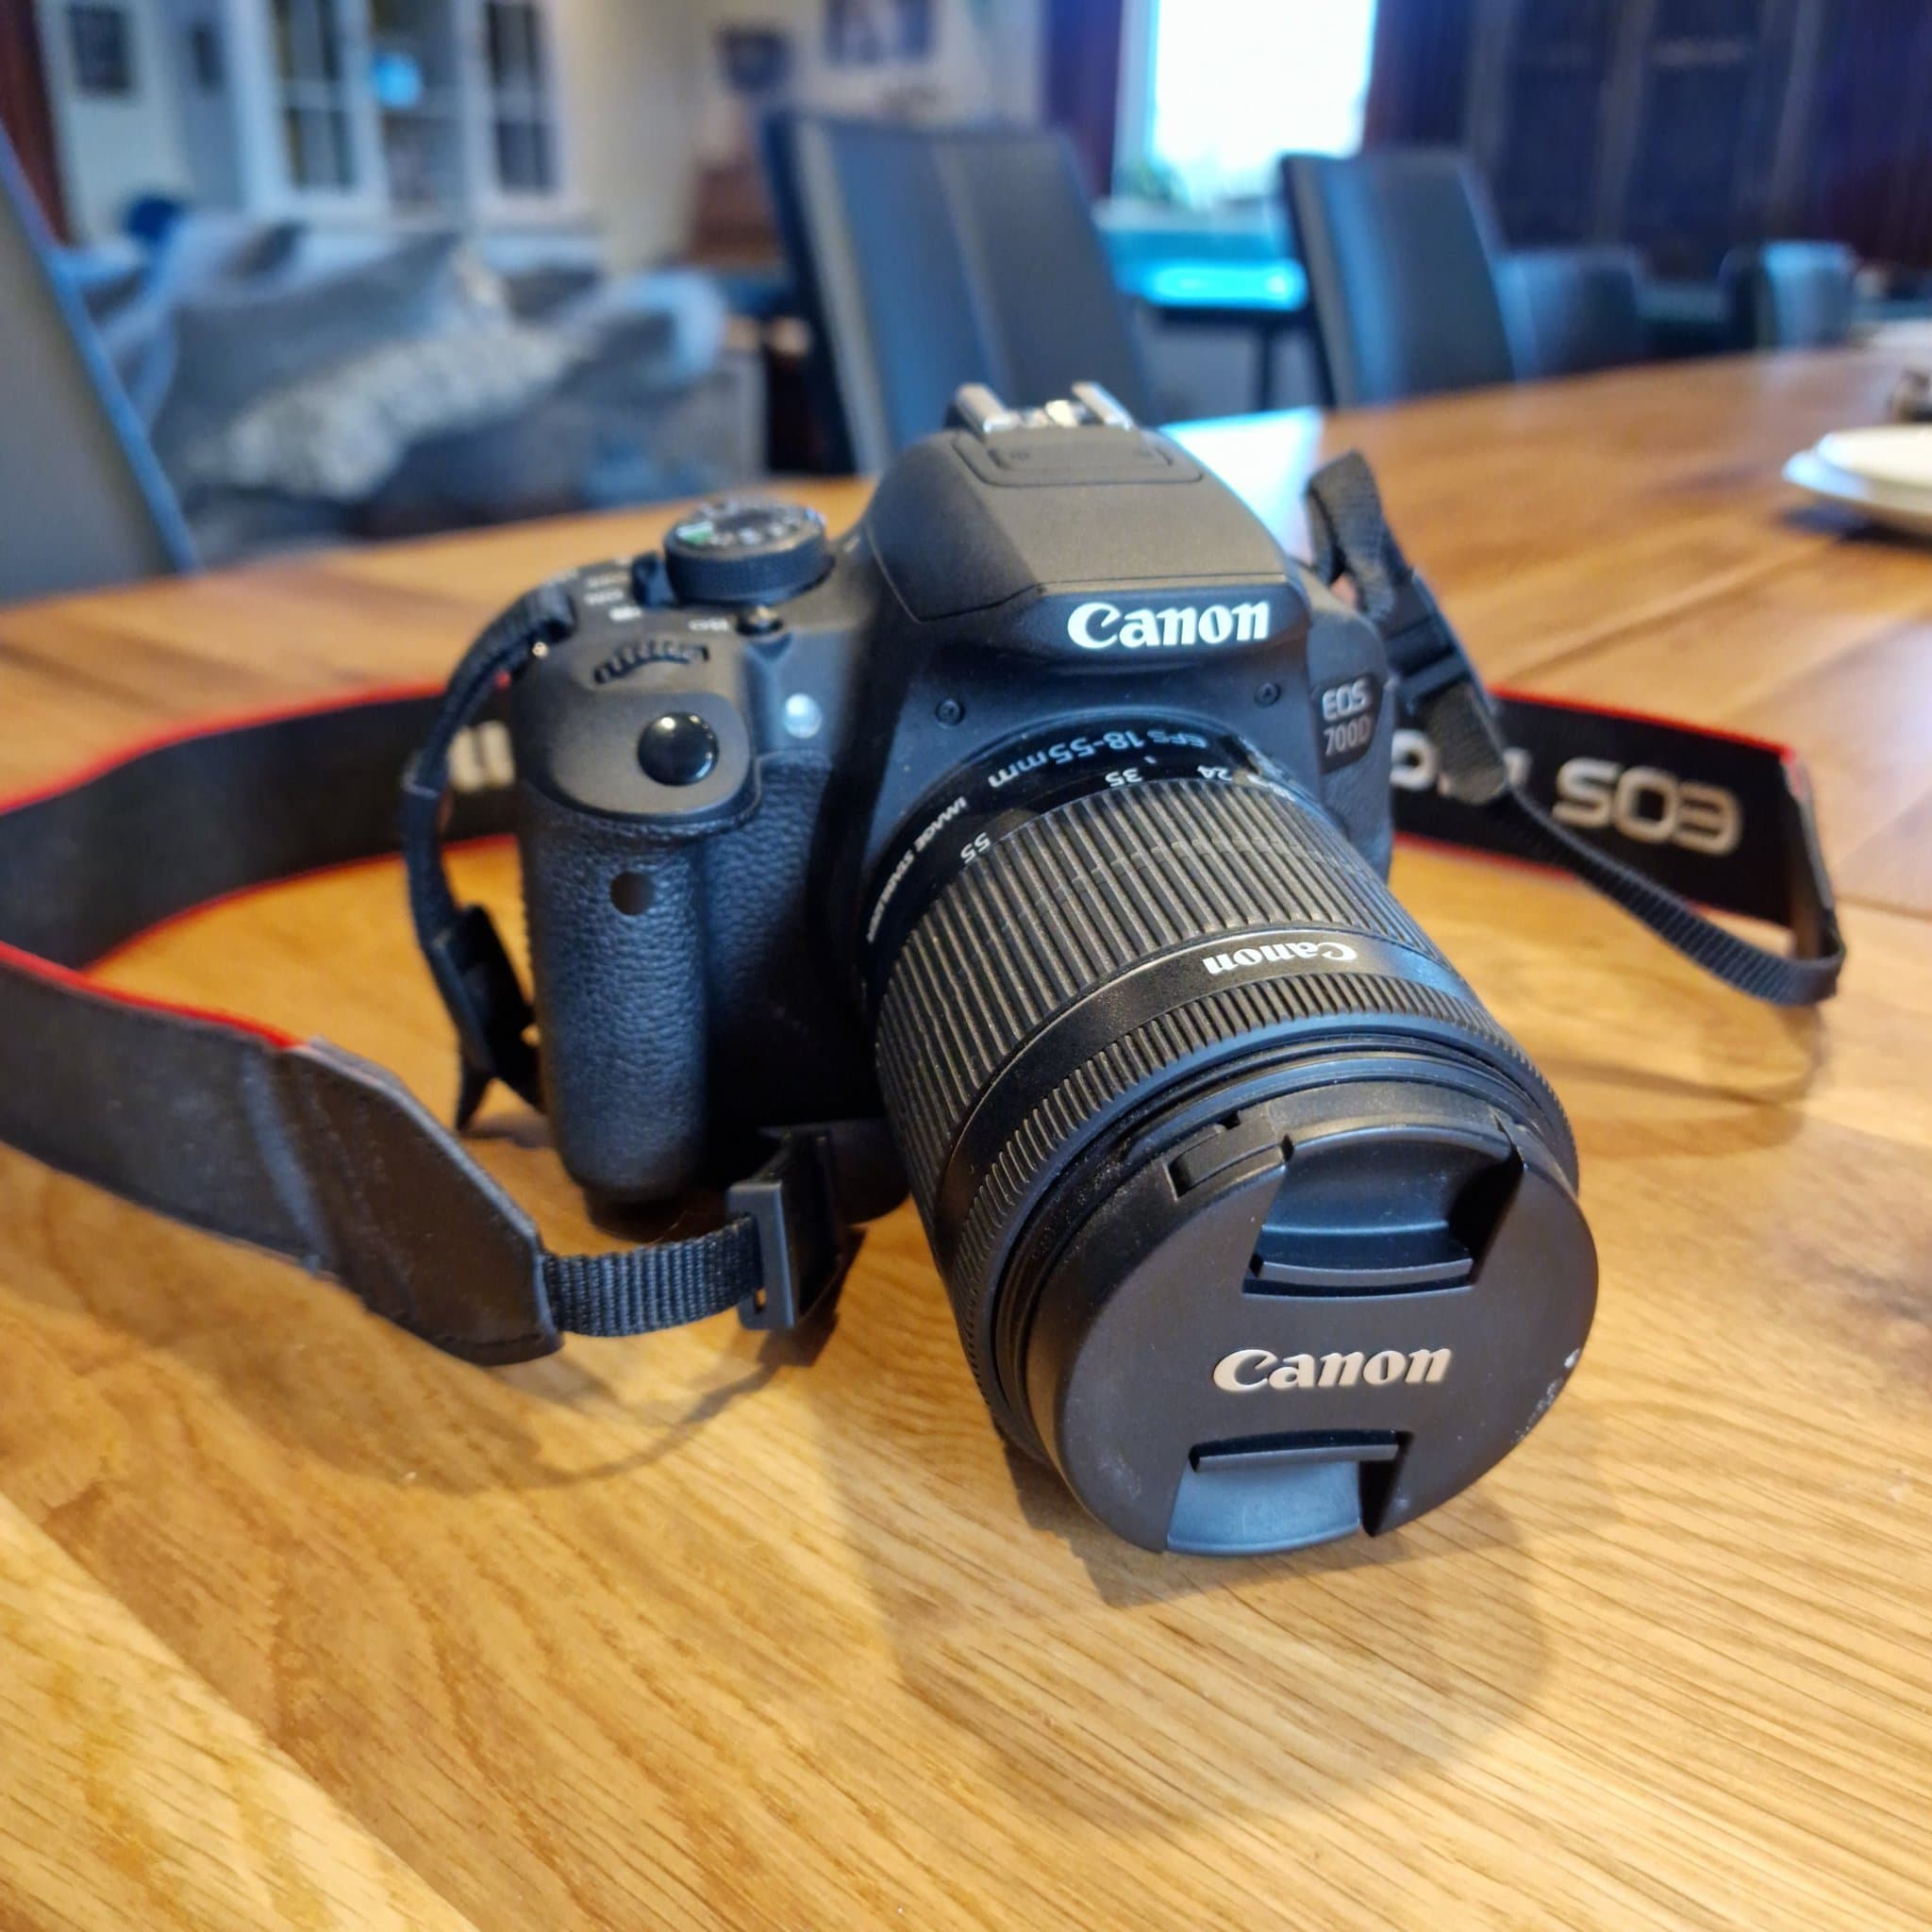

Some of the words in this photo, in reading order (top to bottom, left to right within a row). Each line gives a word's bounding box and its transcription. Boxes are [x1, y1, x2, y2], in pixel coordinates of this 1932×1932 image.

[1067, 601, 1272, 650] Canon
[1322, 678, 1369, 722] EOS
[1324, 715, 1372, 756] 700D
[988, 729, 1145, 788] 18-55mm
[1105, 767, 1144, 789] 35
[1552, 757, 1742, 856] EOS
[960, 832, 991, 865] 55
[1203, 940, 1358, 975] Canon
[1213, 1347, 1452, 1392] Canon
